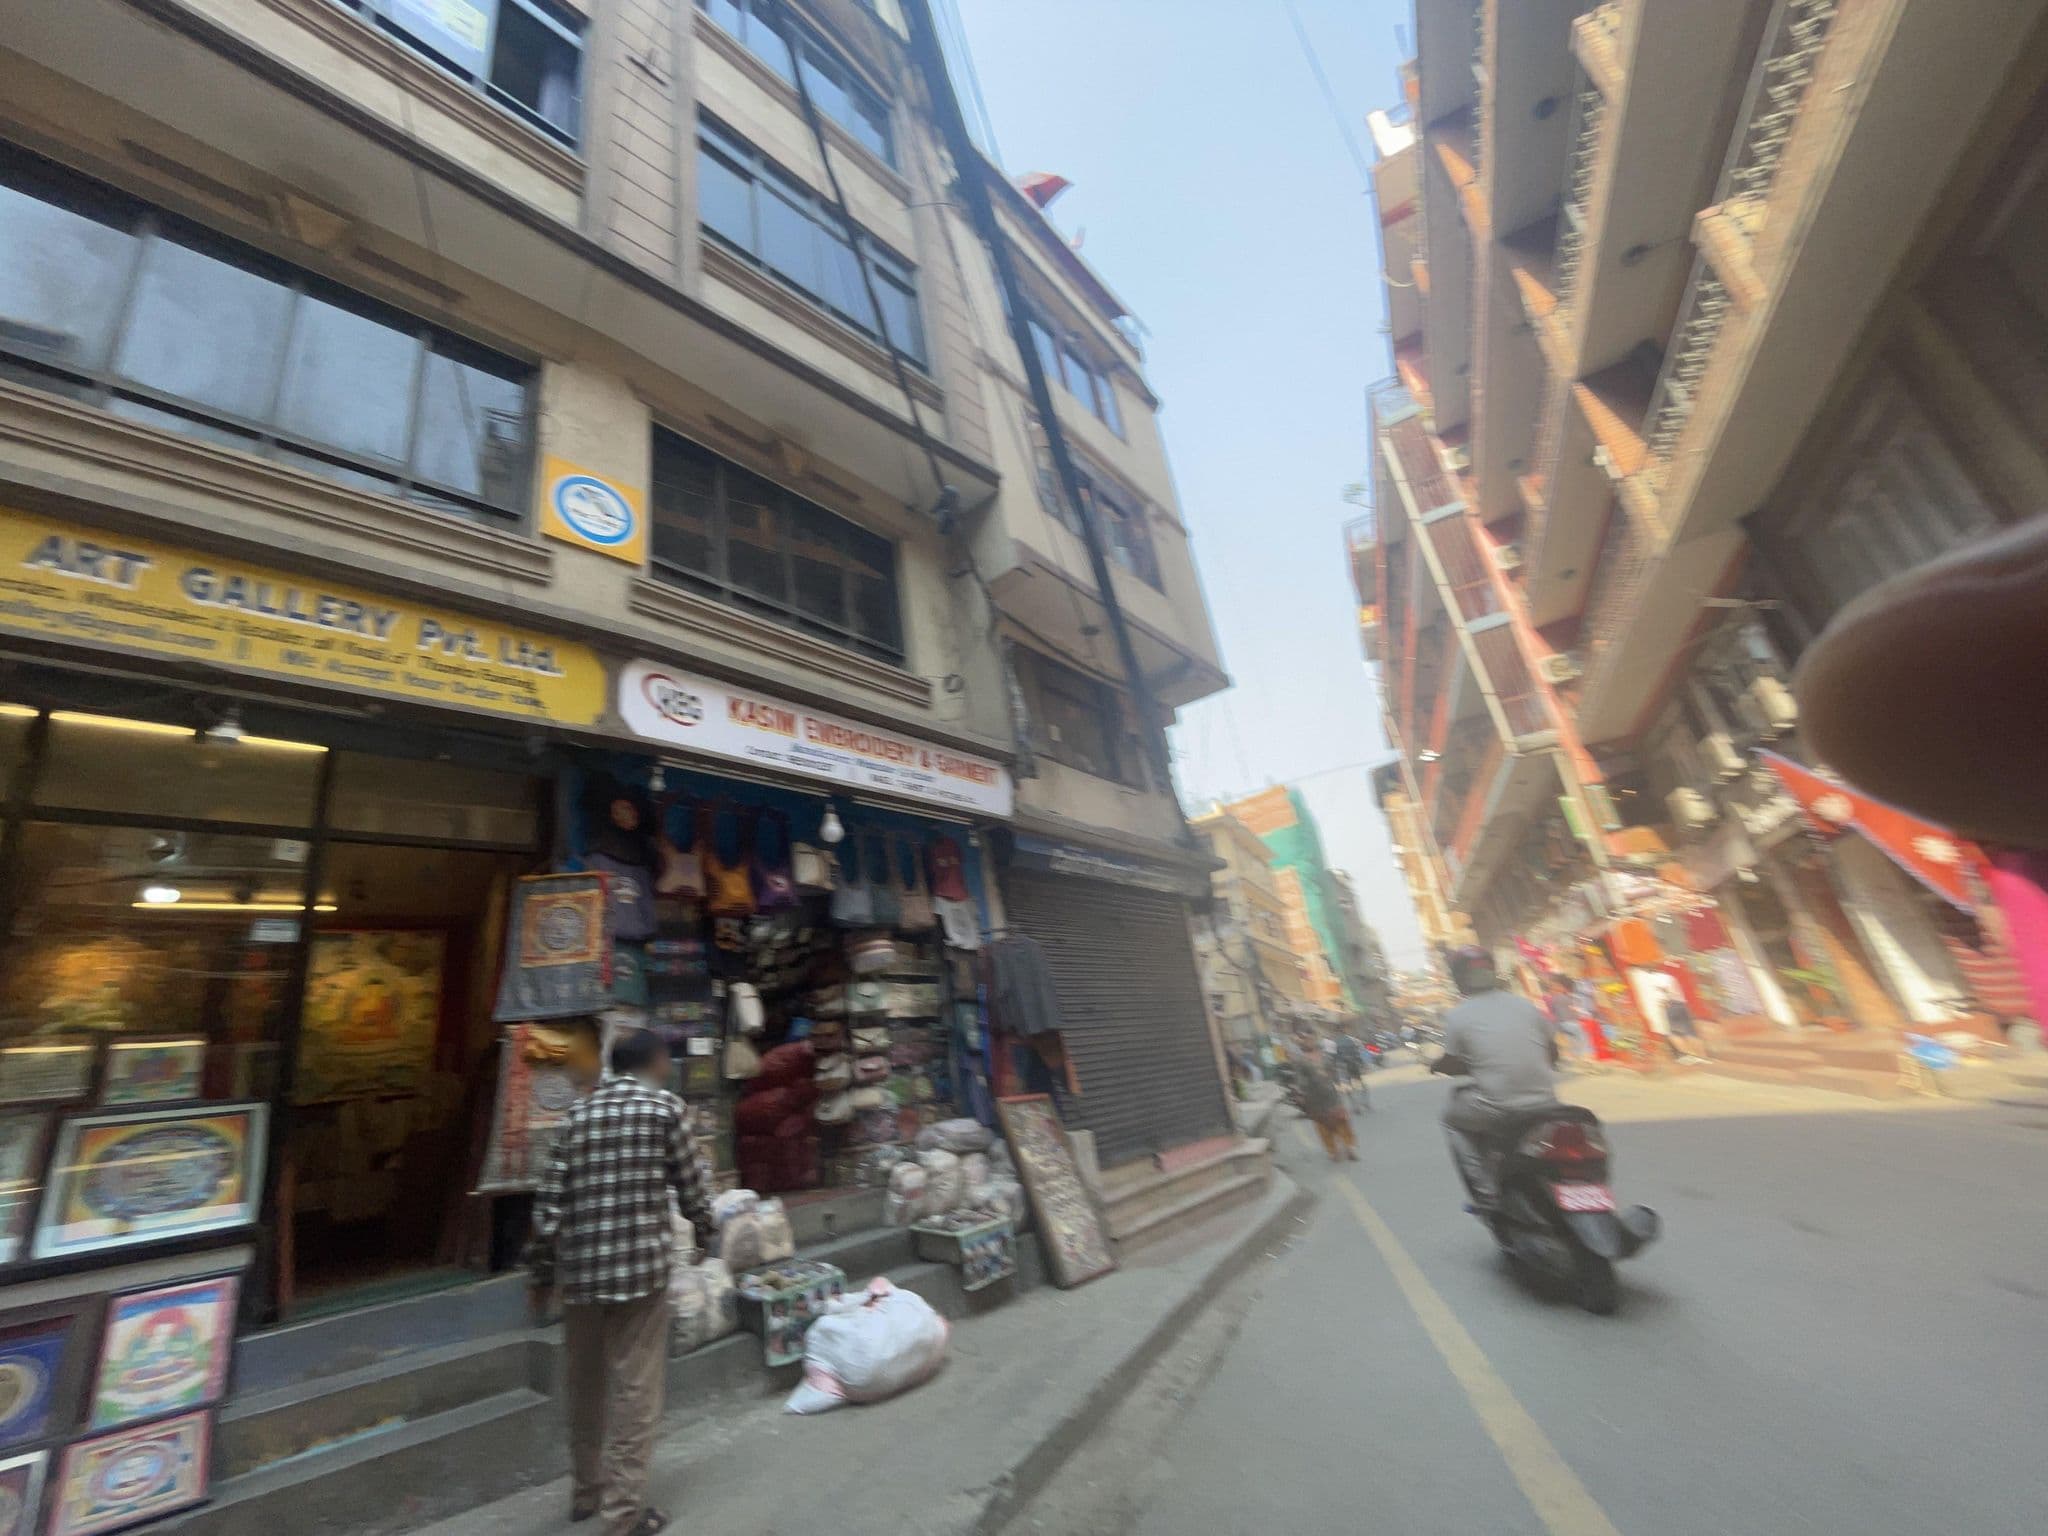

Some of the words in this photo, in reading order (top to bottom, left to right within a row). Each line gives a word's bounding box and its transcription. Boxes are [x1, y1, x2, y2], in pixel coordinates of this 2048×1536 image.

[23, 536, 150, 588] ART
[182, 568, 397, 641] GALLERY
[416, 619, 490, 661] Pvt.
[500, 637, 564, 676] Ltd.
